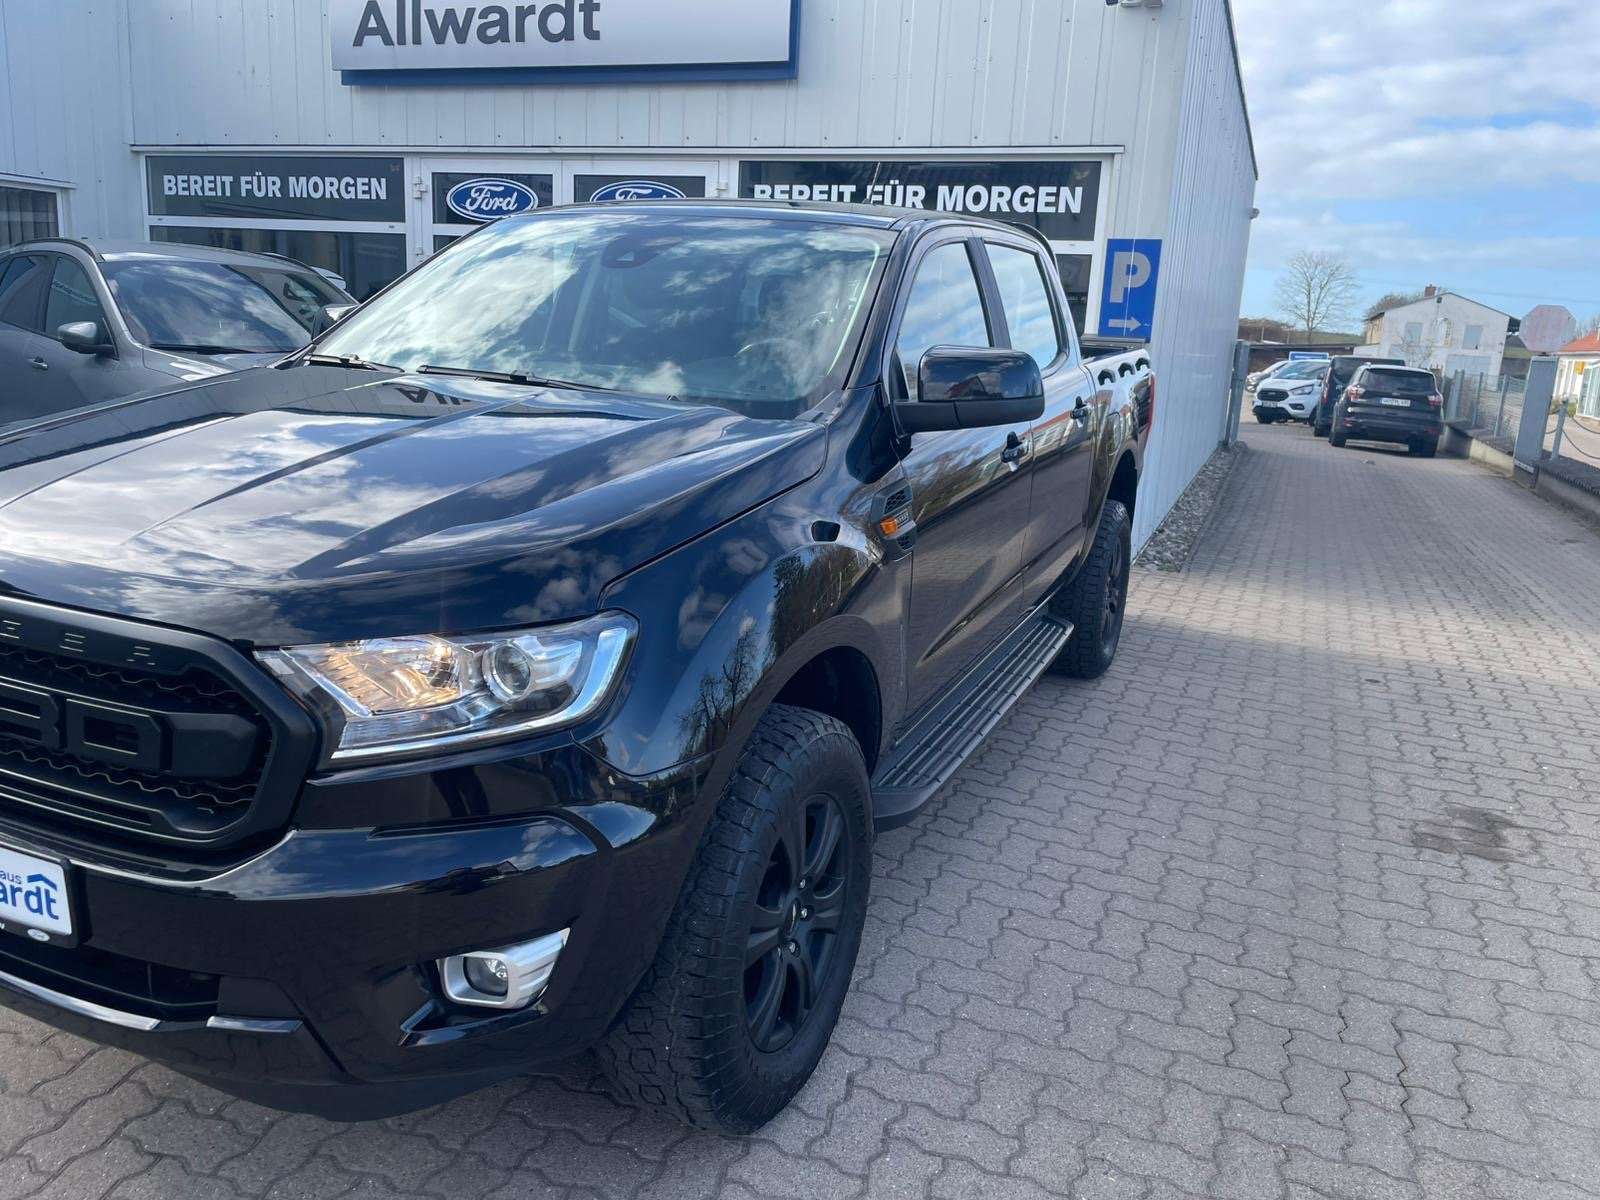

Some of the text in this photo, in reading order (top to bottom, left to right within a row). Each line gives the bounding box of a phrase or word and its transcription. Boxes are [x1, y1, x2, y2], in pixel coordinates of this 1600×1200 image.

[352, 0, 601, 47] Allwardt
[163, 171, 388, 200] BEREIT FÜR MORGEN
[463, 183, 518, 214] Ford
[866, 179, 926, 208] FÜR
[936, 185, 1083, 213] MORGEN
[1109, 251, 1152, 304] P
